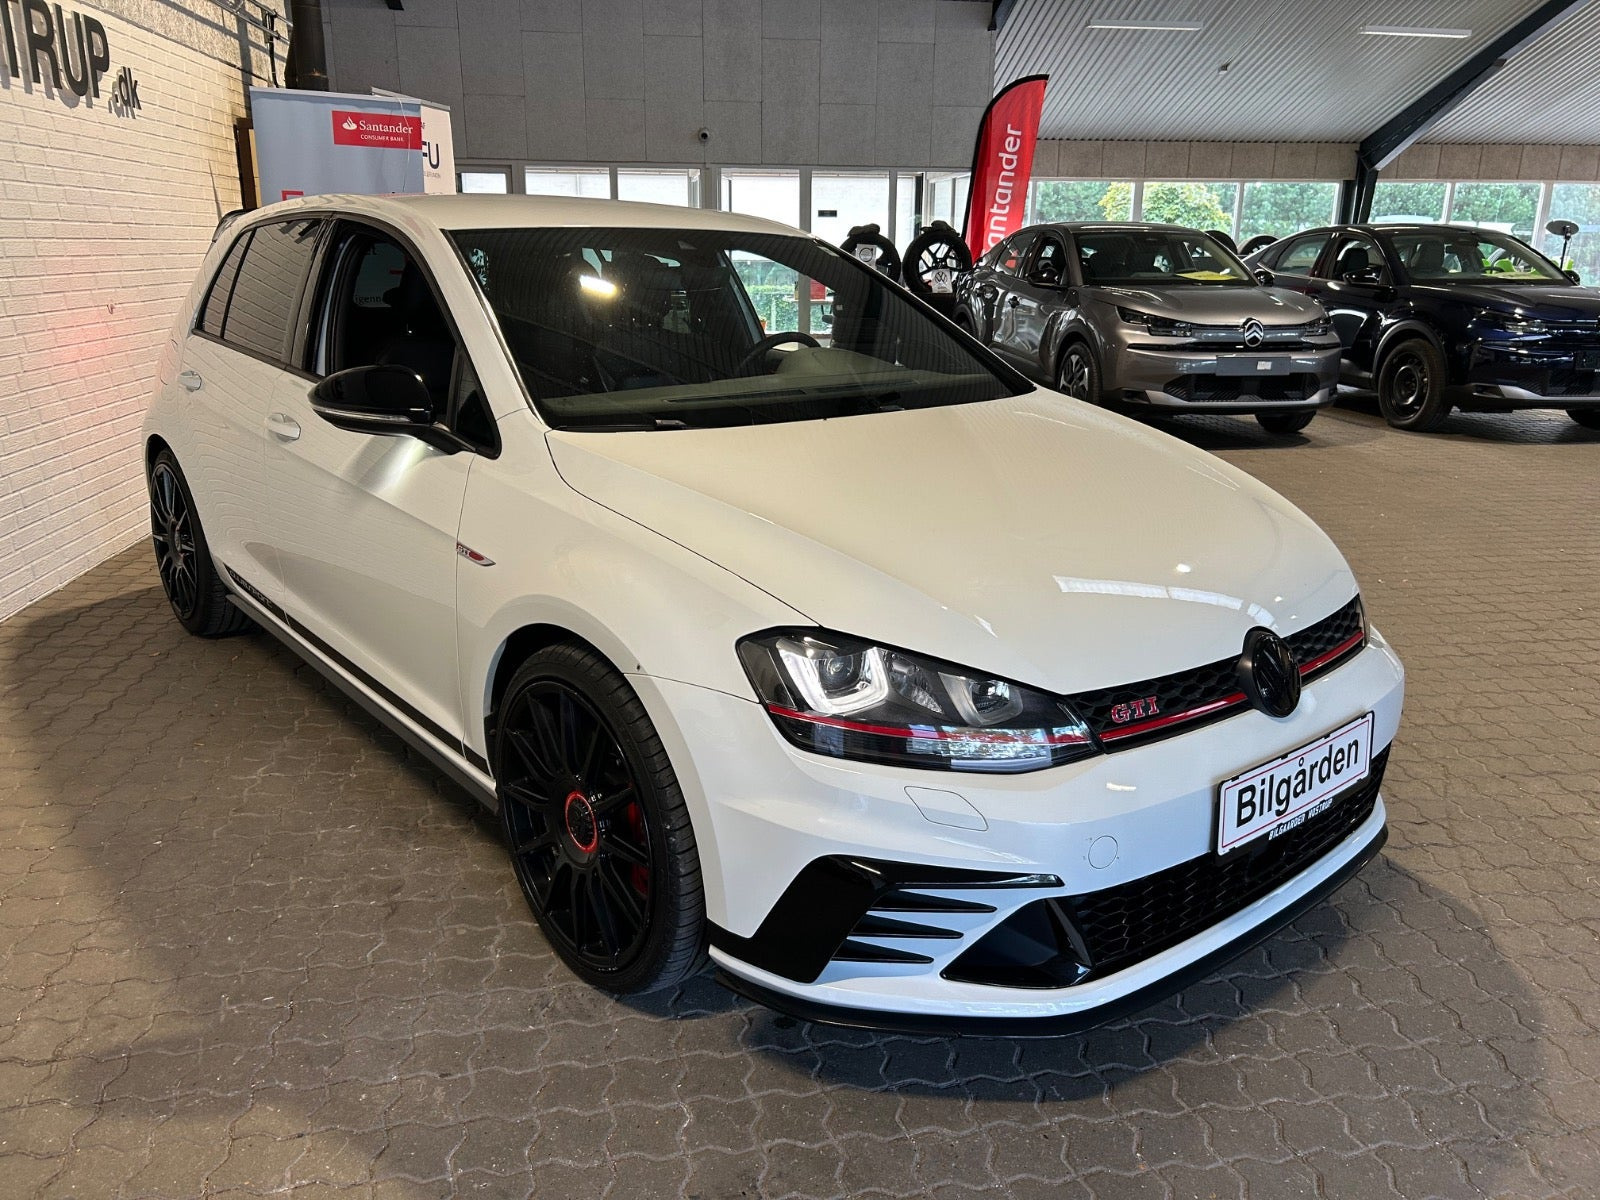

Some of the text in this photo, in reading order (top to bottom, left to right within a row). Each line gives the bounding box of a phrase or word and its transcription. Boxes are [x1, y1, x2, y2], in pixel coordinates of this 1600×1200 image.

[359, 119, 414, 134] Santander
[984, 123, 1022, 254] antander
[1111, 696, 1160, 723] GTI
[1236, 738, 1359, 828] Bilgården
